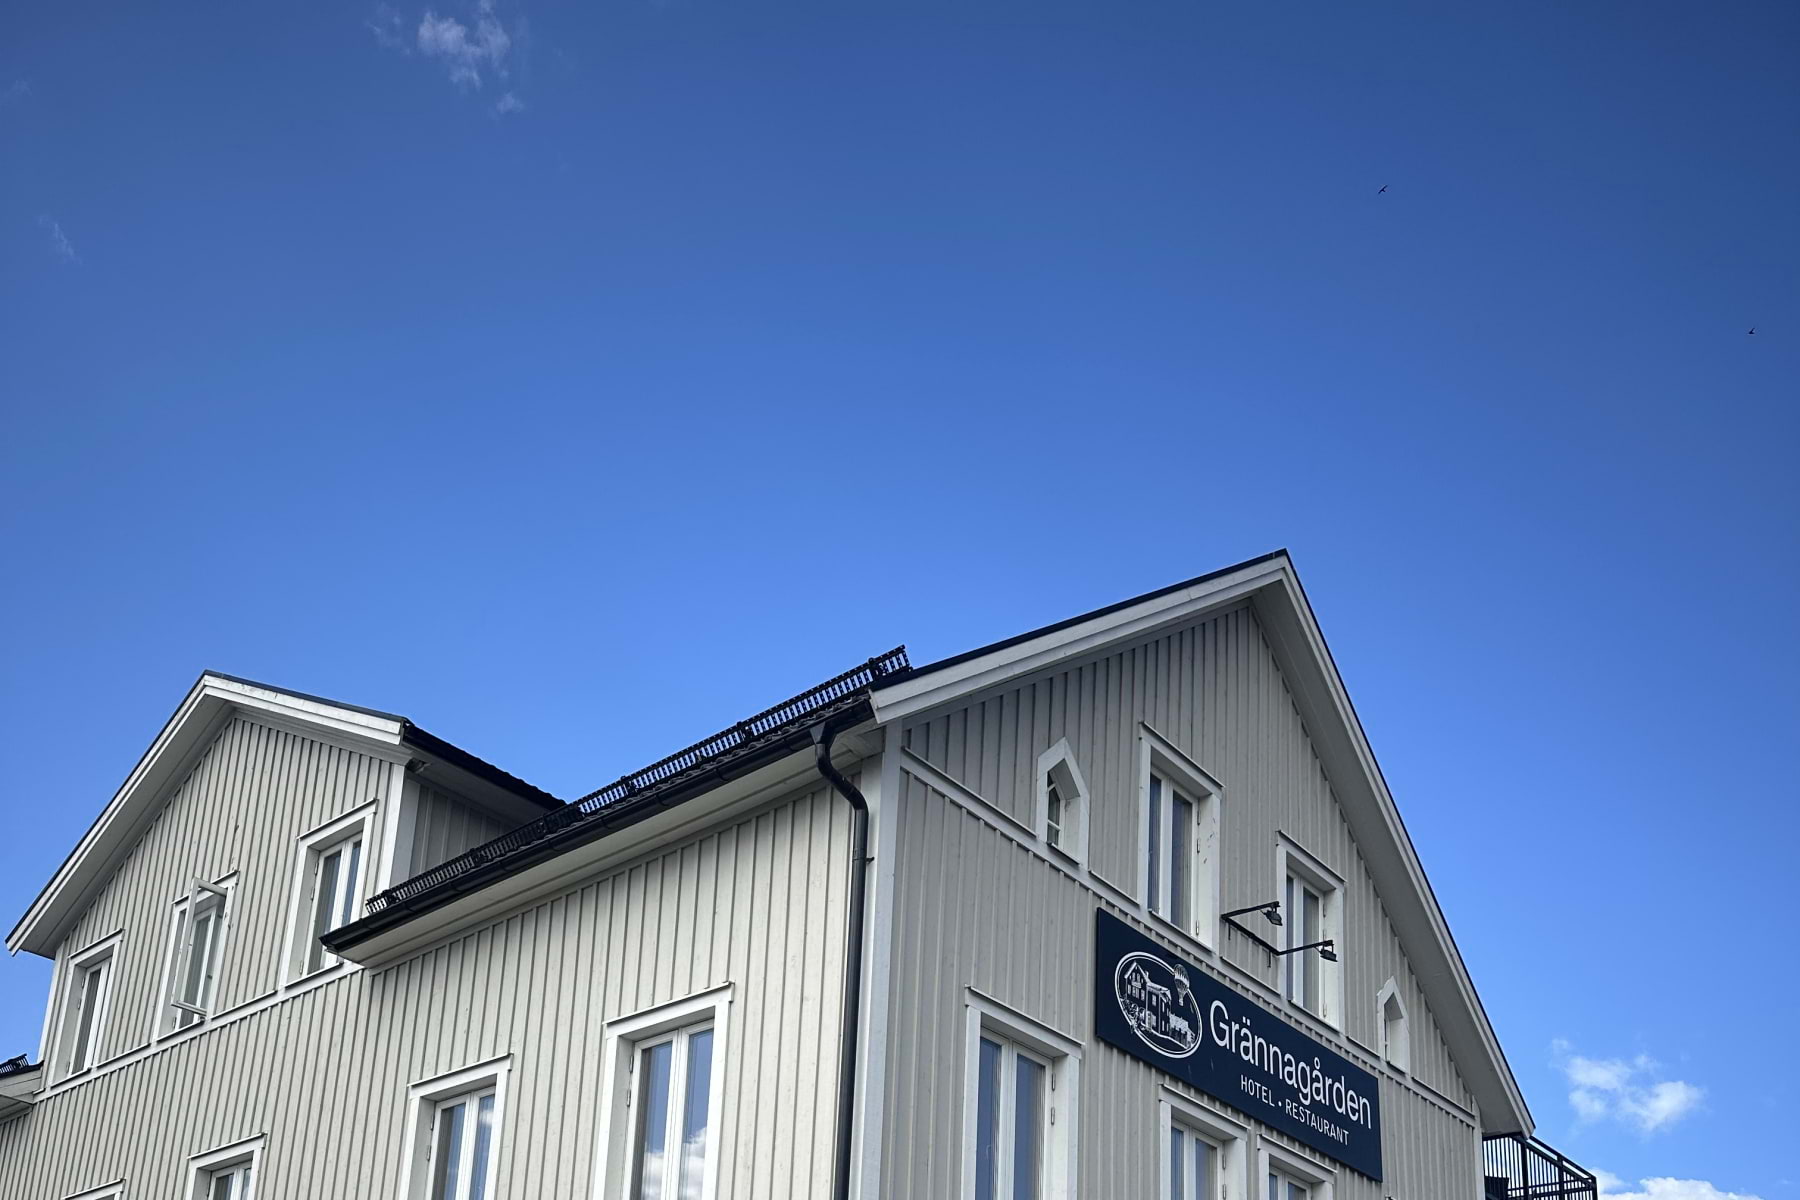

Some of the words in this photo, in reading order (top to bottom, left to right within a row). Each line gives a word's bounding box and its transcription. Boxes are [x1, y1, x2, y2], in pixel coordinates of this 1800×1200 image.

[1209, 1000, 1371, 1129] Grännagården
[1240, 1074, 1275, 1107] HOTEL
[1285, 1099, 1349, 1146] RESTAURANT
